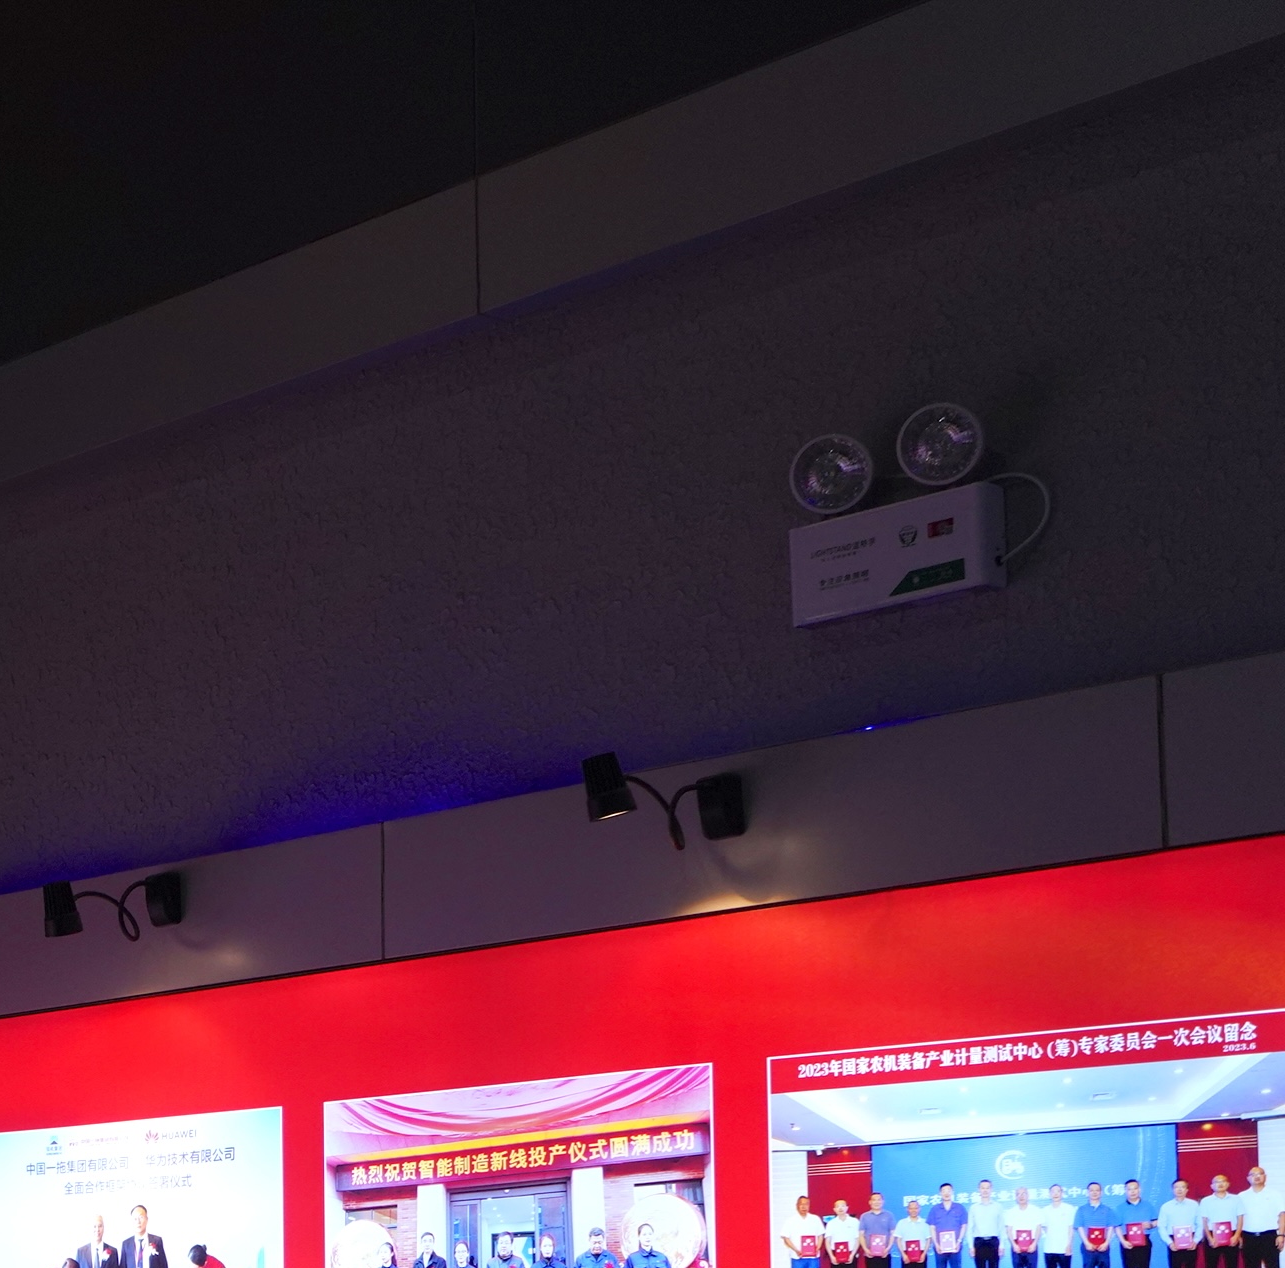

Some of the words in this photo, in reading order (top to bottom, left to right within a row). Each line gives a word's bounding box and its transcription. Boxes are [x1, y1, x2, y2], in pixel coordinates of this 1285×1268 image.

[1222, 1042, 1257, 1054] 2023.6
[161, 1129, 198, 1141] HUAWEI
[25, 1156, 130, 1177] 中国一拖集团有限公司
[144, 1147, 236, 1168] 华为技术有限公司
[351, 1128, 696, 1186] 热烈祝贺智能制造新线投产仪式圆满成功
